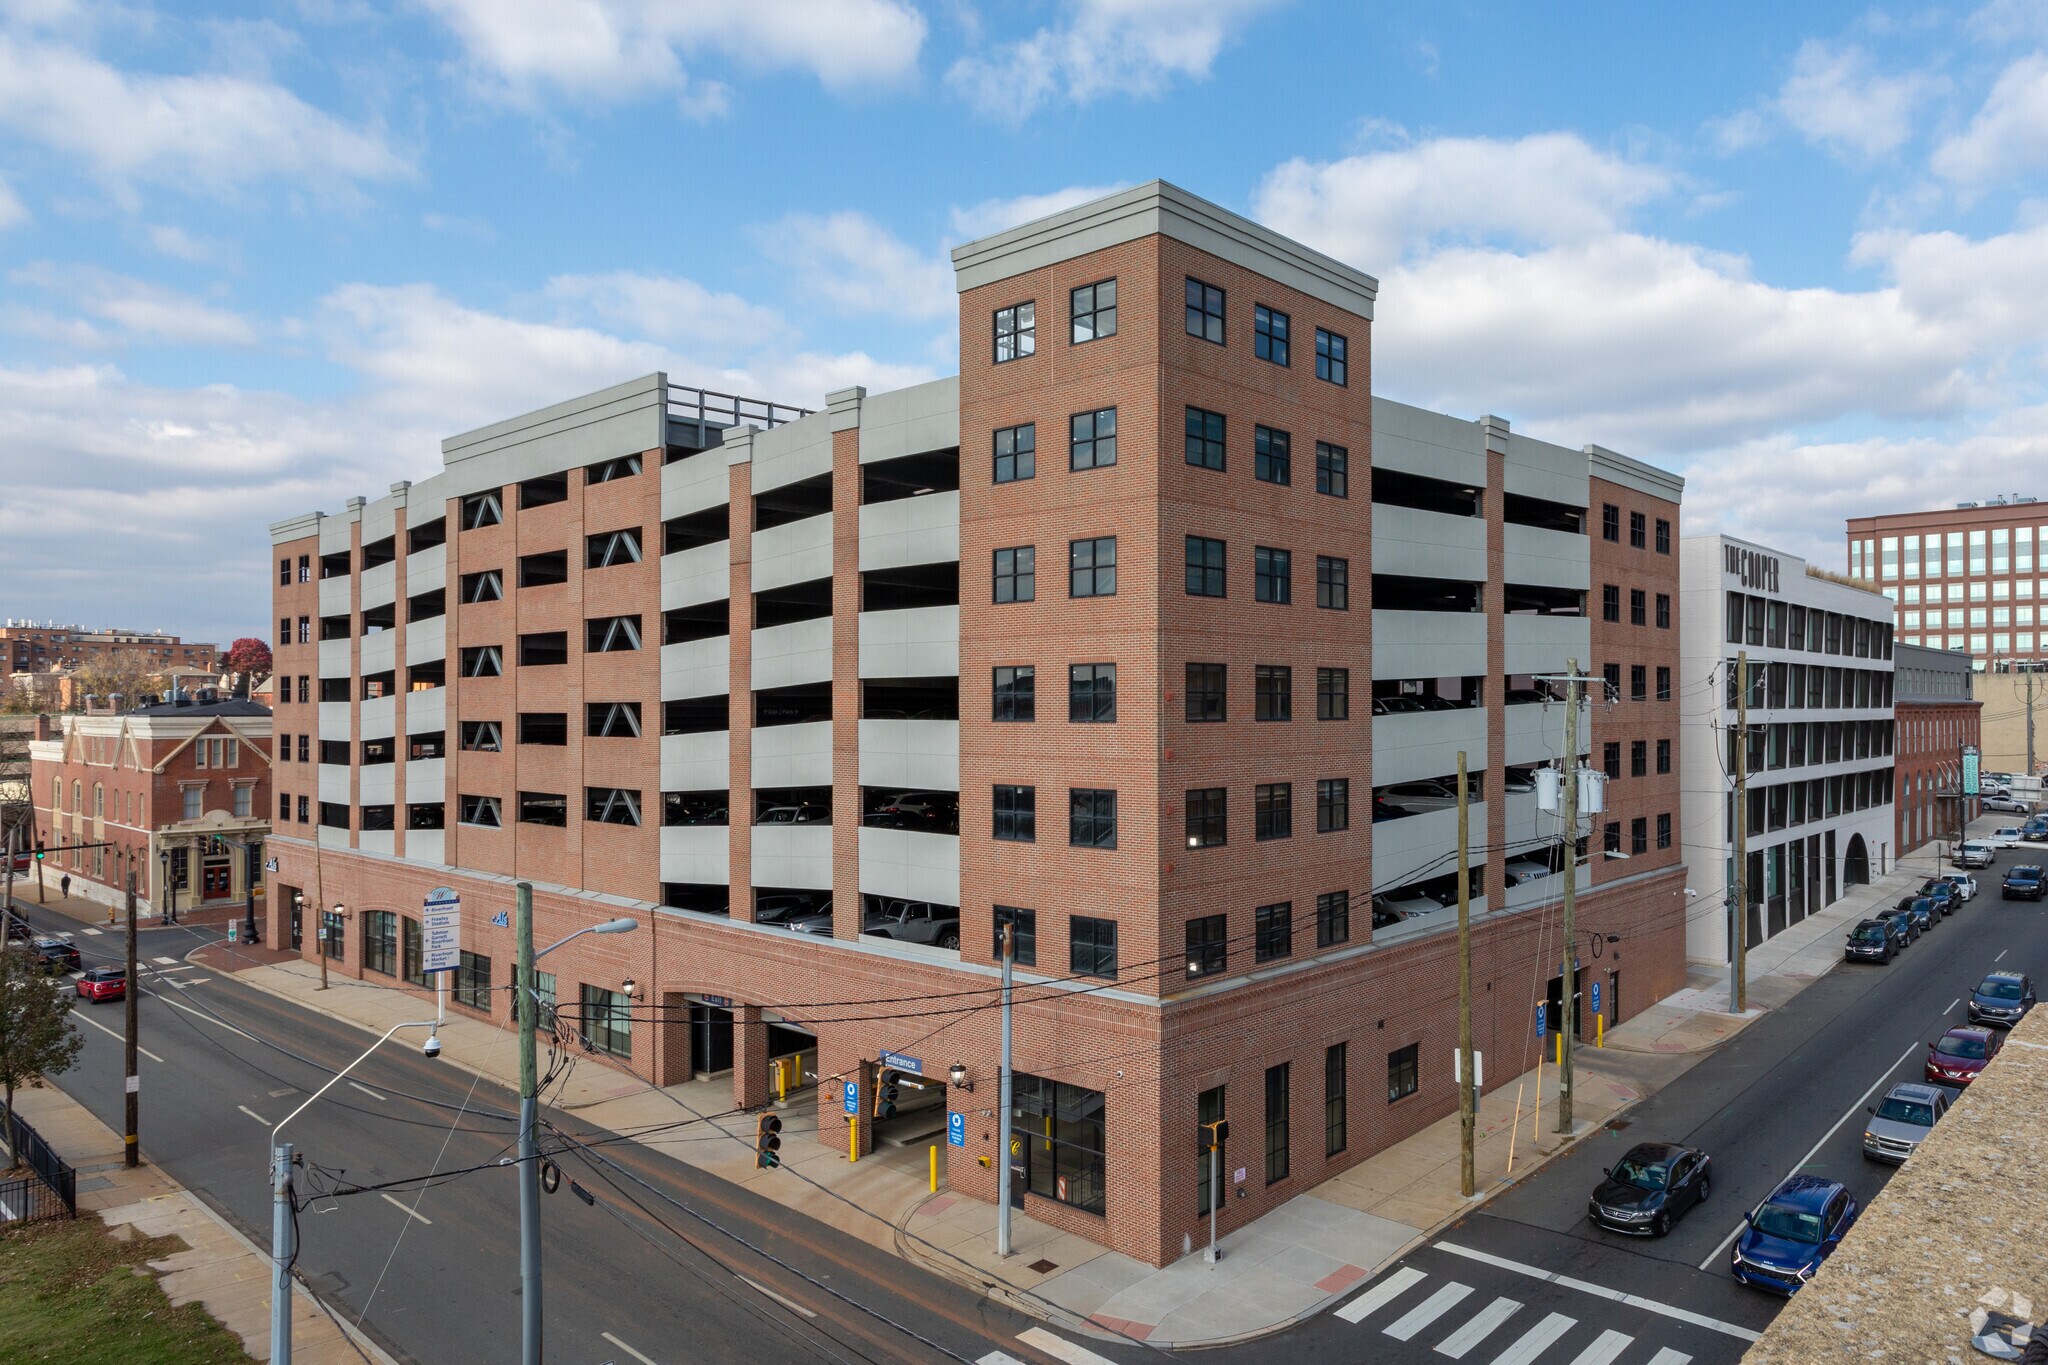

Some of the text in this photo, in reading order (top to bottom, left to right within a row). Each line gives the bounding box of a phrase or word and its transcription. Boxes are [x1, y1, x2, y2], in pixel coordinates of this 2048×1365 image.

[1724, 544, 1779, 593] THE COOPER
[885, 1053, 916, 1069] Entrance
